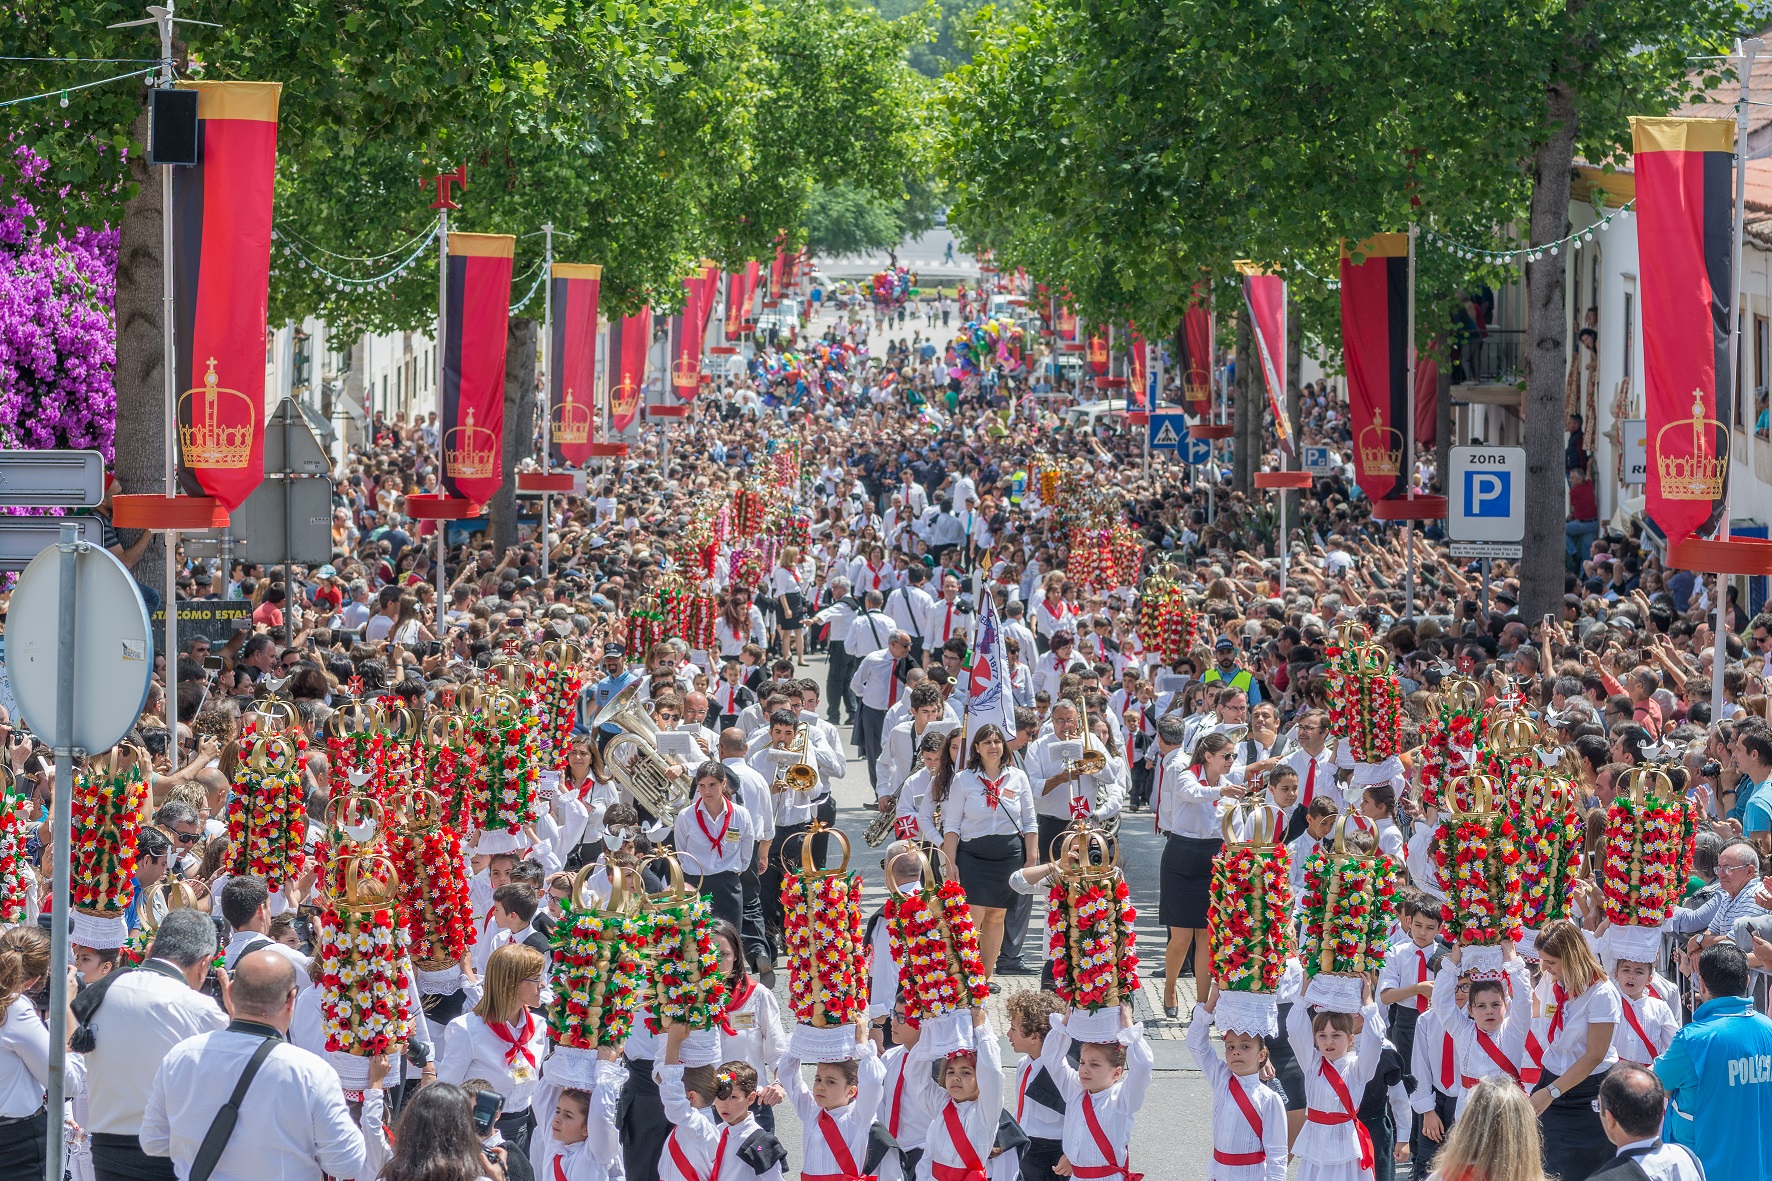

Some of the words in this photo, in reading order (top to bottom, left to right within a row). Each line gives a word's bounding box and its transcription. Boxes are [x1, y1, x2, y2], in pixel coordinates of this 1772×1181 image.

[1469, 454, 1506, 464] zona
[988, 655, 999, 680] 1877
[1727, 1053, 1772, 1087] POLÍCI
